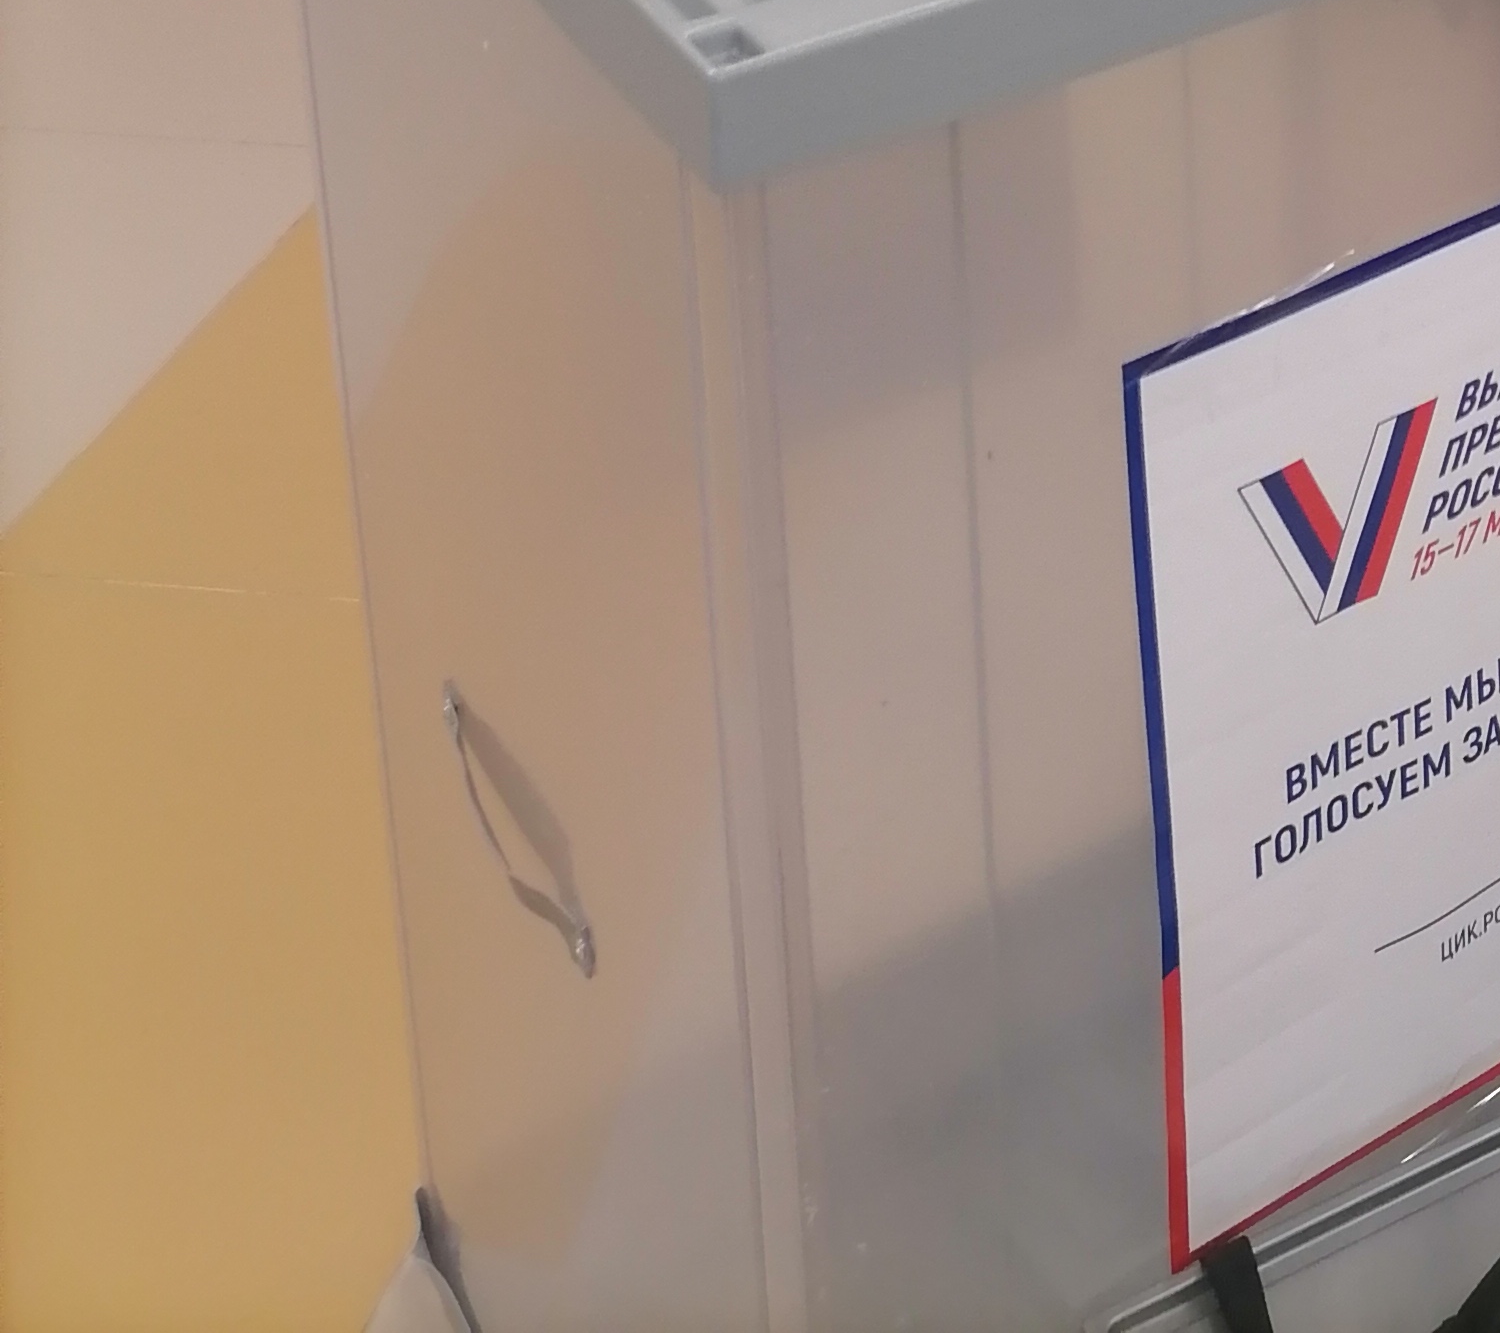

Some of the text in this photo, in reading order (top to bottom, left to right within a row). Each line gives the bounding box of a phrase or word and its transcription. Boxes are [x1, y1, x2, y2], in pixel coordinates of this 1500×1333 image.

[1409, 517, 1483, 581] 15–17
[1285, 696, 1434, 805] ВМЕСТЕ
[1254, 740, 1453, 880] ГОЛОСУЕМ
